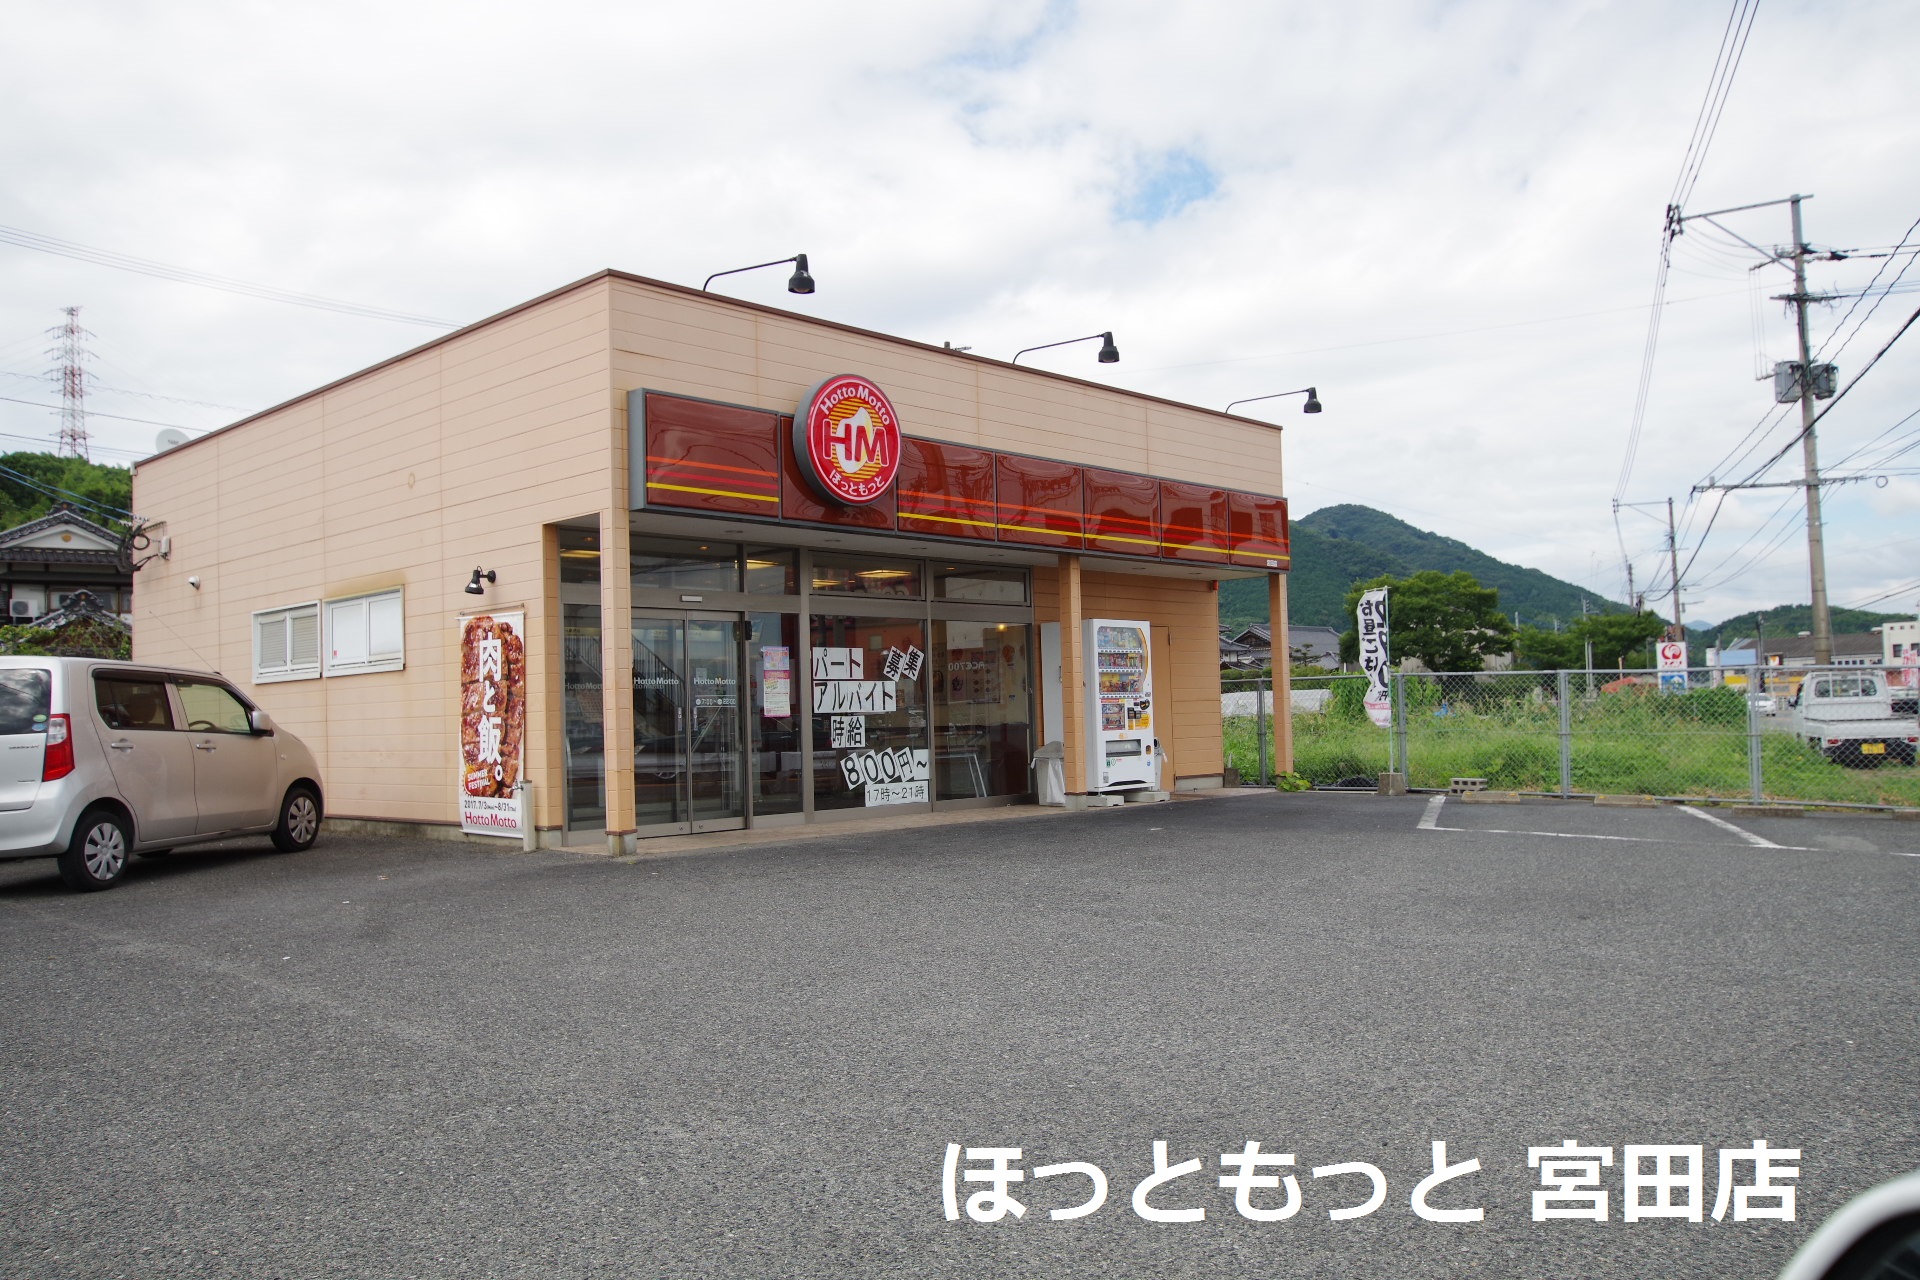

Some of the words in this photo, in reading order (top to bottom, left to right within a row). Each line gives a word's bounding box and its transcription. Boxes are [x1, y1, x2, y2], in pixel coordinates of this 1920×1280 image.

[822, 418, 890, 467] HM
[828, 469, 885, 495] ほっともっと
[814, 647, 861, 677] パート
[885, 648, 921, 678] 募集
[814, 680, 894, 711] アルバイト
[832, 716, 863, 747] 時給
[467, 768, 488, 781] SUMMER
[468, 778, 490, 791] FESTIVAL
